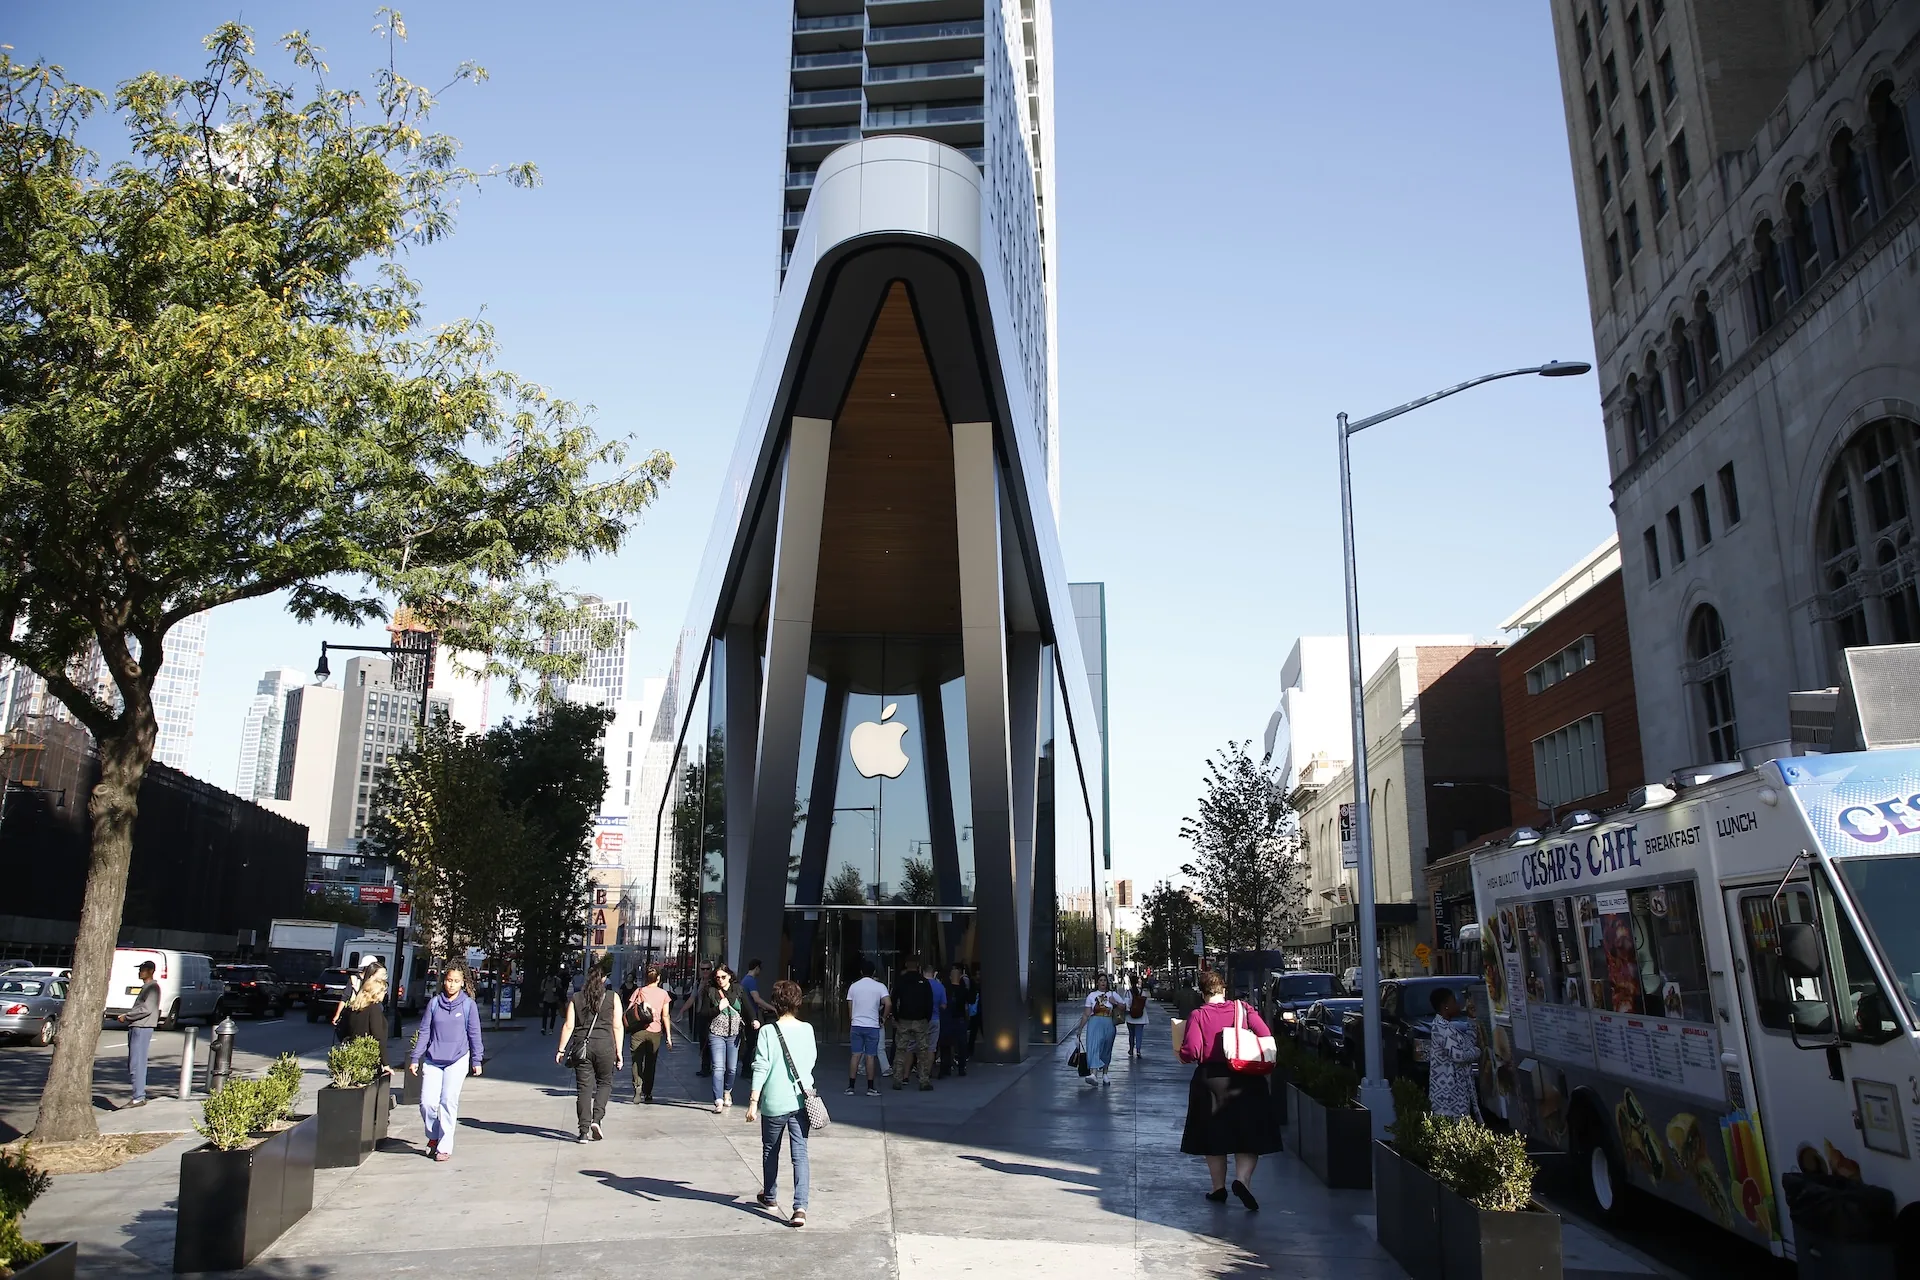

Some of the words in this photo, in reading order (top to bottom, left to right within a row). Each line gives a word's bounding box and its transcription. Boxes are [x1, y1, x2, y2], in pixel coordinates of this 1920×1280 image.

[1716, 811, 1758, 838] LUNCH
[1644, 826, 1701, 855] BREAKFAST
[1521, 843, 1582, 890] CESAR'S
[1586, 823, 1642, 876] CAFE
[1486, 876, 1498, 890] HIGH
[1498, 870, 1520, 887] QUALITY
